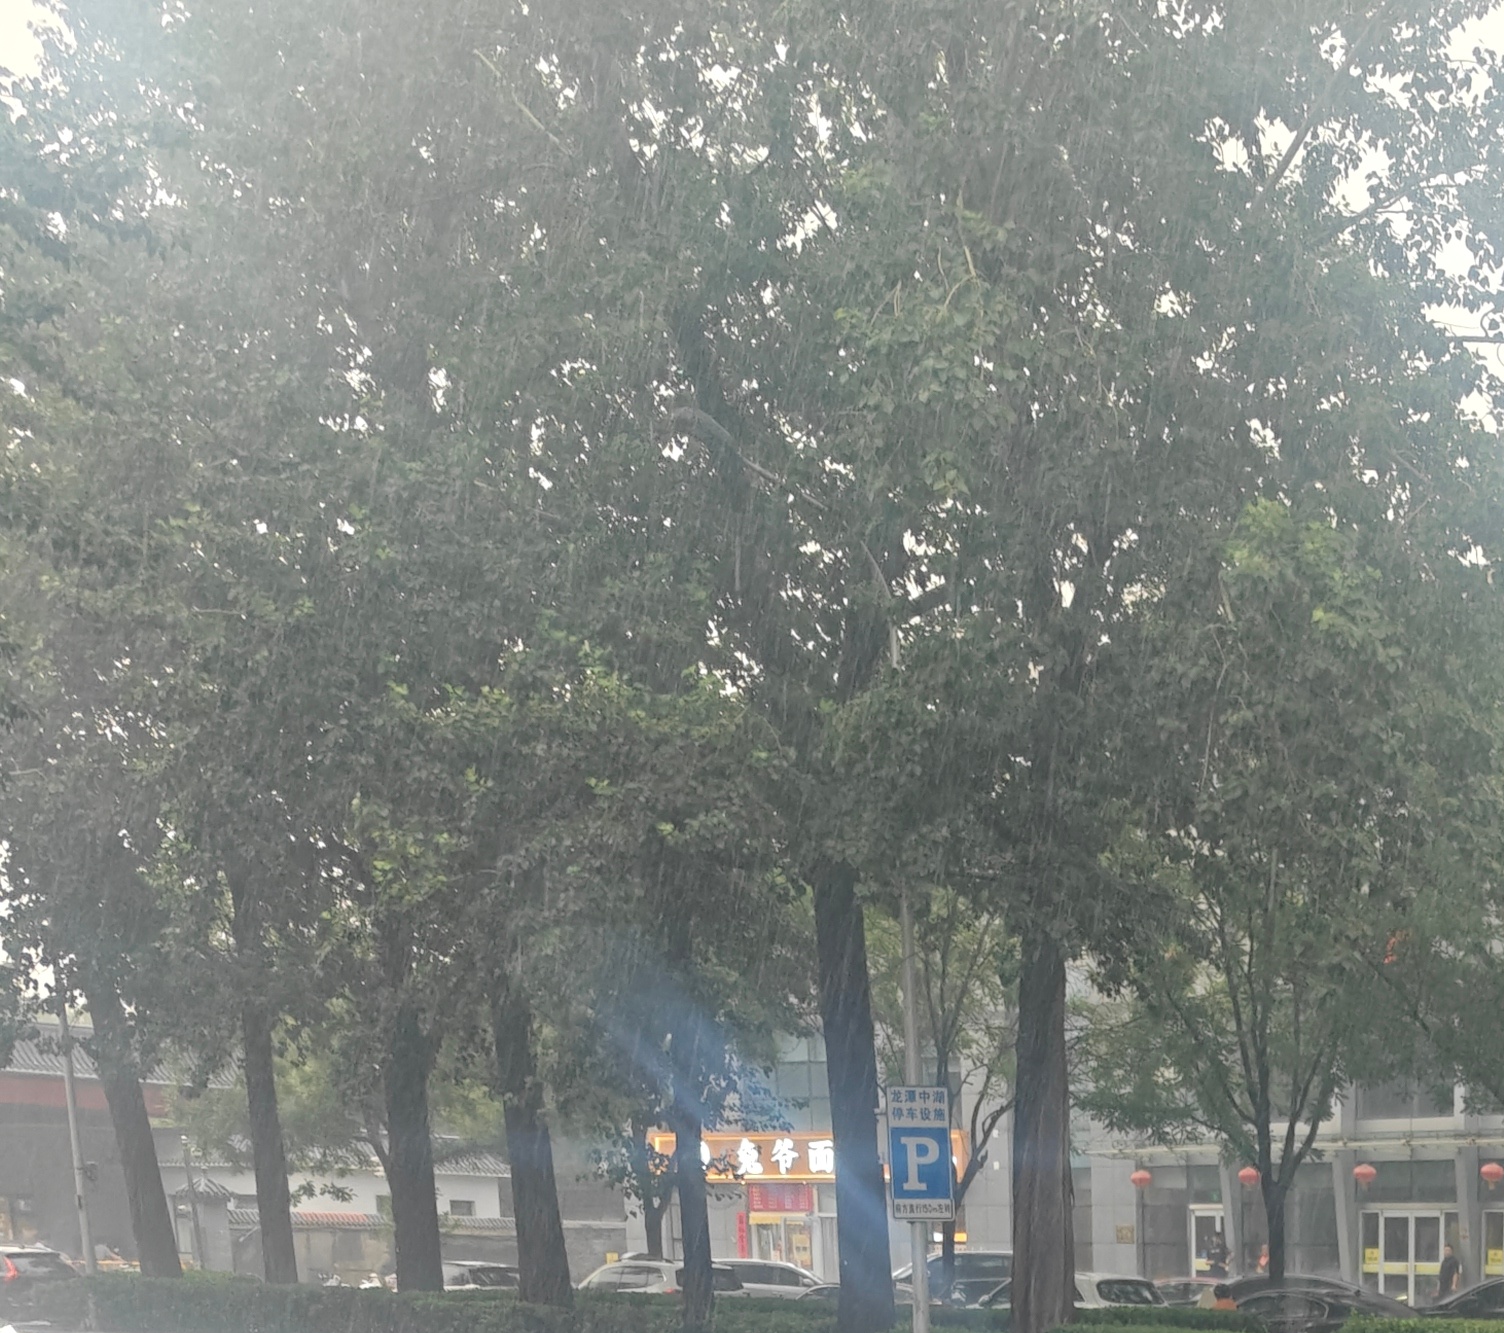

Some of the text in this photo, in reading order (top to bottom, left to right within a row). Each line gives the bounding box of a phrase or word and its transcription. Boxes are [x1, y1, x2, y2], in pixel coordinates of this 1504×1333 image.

[891, 1089, 946, 1105] 龙潭中湖
[892, 1107, 946, 1121] 停车设施
[900, 1136, 940, 1190] P
